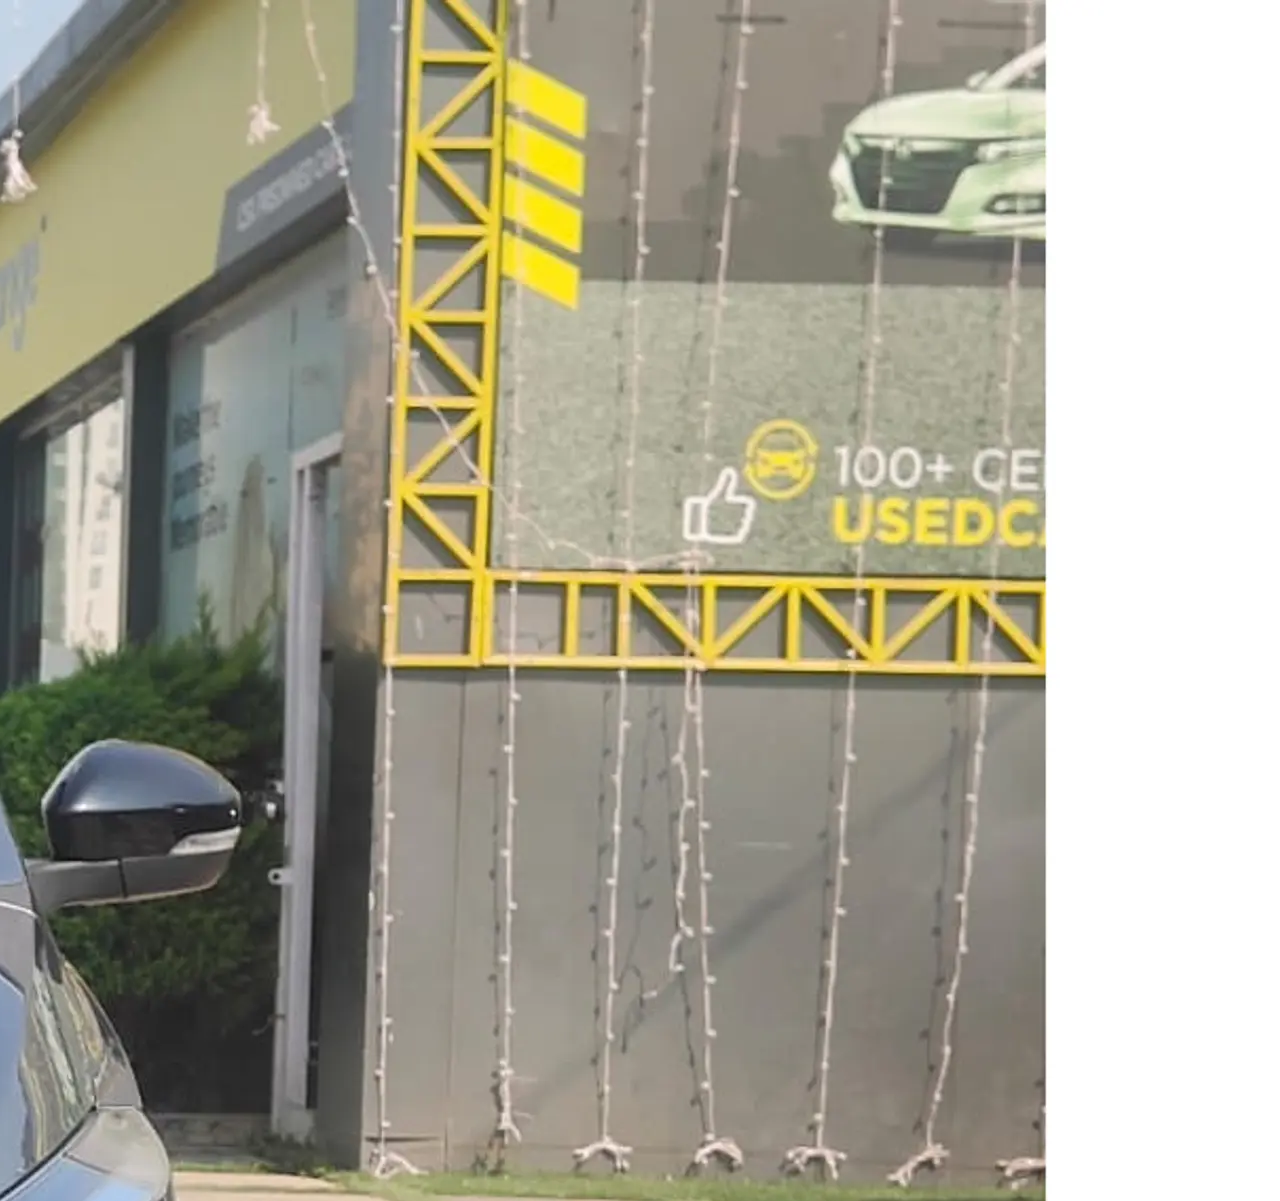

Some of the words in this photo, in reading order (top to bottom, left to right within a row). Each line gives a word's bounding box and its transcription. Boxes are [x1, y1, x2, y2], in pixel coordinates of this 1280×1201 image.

[834, 445, 953, 488] 100+
[972, 448, 1046, 491] CE
[832, 494, 1046, 547] USEDC
